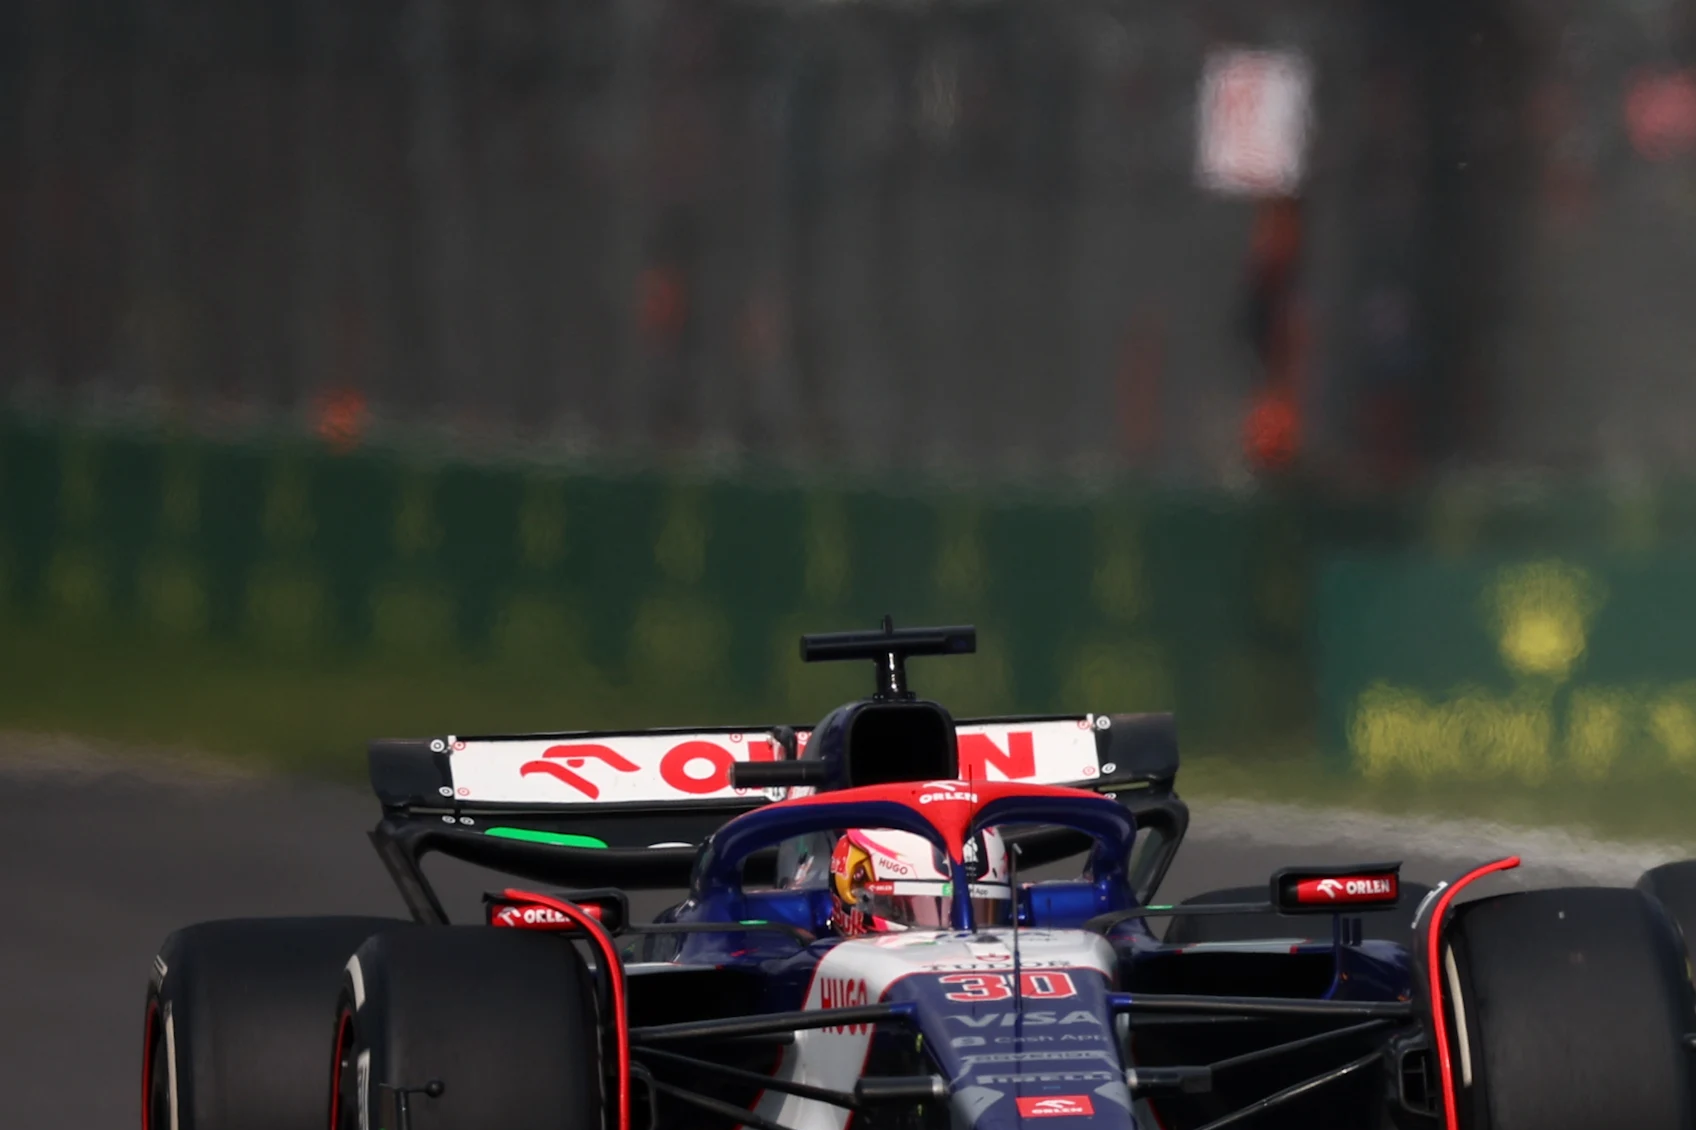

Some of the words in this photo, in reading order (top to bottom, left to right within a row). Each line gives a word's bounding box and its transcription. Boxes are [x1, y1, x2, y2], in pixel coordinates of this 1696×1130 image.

[919, 792, 978, 804] ORLEN
[878, 857, 909, 876] HUGO
[1346, 879, 1390, 895] ORLEN
[523, 908, 572, 924] ORLE
[938, 972, 1078, 1002] 30
[945, 1011, 1102, 1028] VISA
